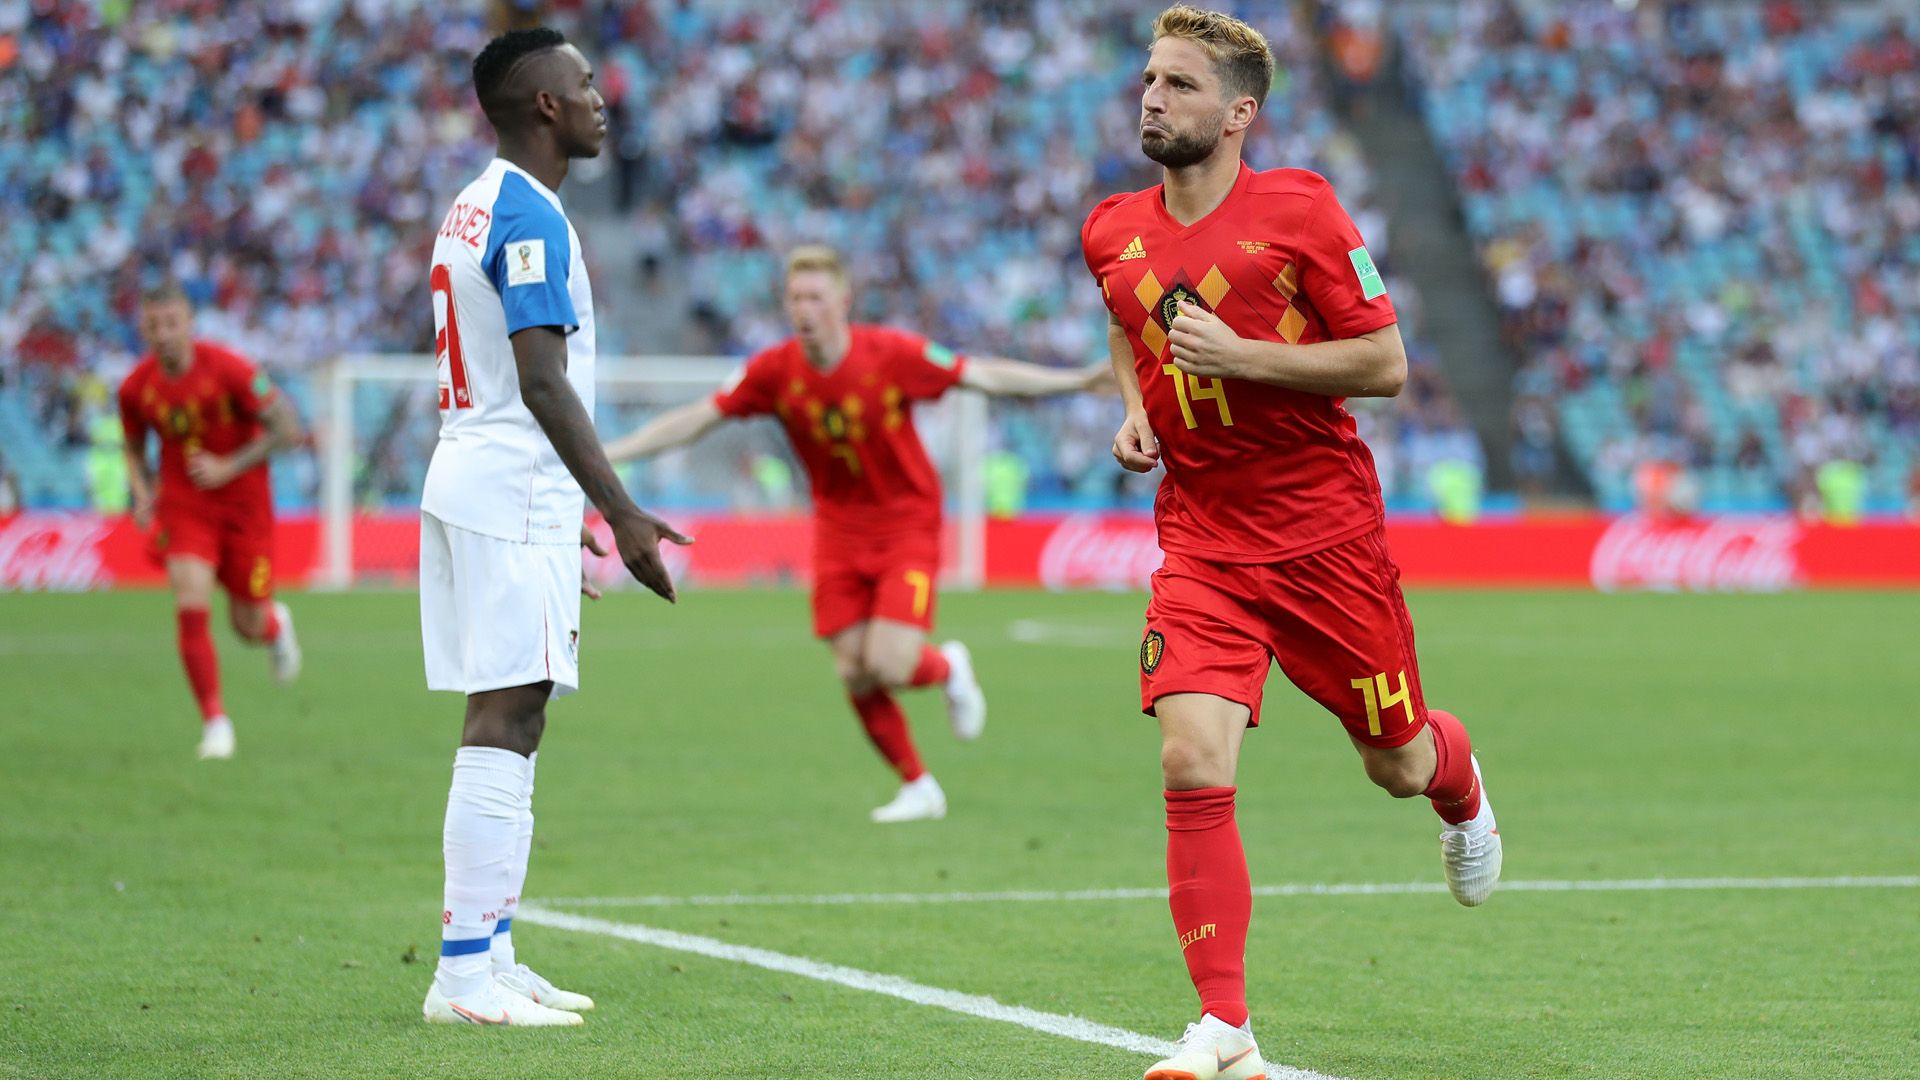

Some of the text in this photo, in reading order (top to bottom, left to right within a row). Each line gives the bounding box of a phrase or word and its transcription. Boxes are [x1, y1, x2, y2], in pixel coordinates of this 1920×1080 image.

[1119, 250, 1147, 261] adidas
[1162, 363, 1235, 430] 14
[903, 568, 930, 619] 7
[1350, 669, 1415, 737] 14
[1180, 923, 1217, 951] GIUM
